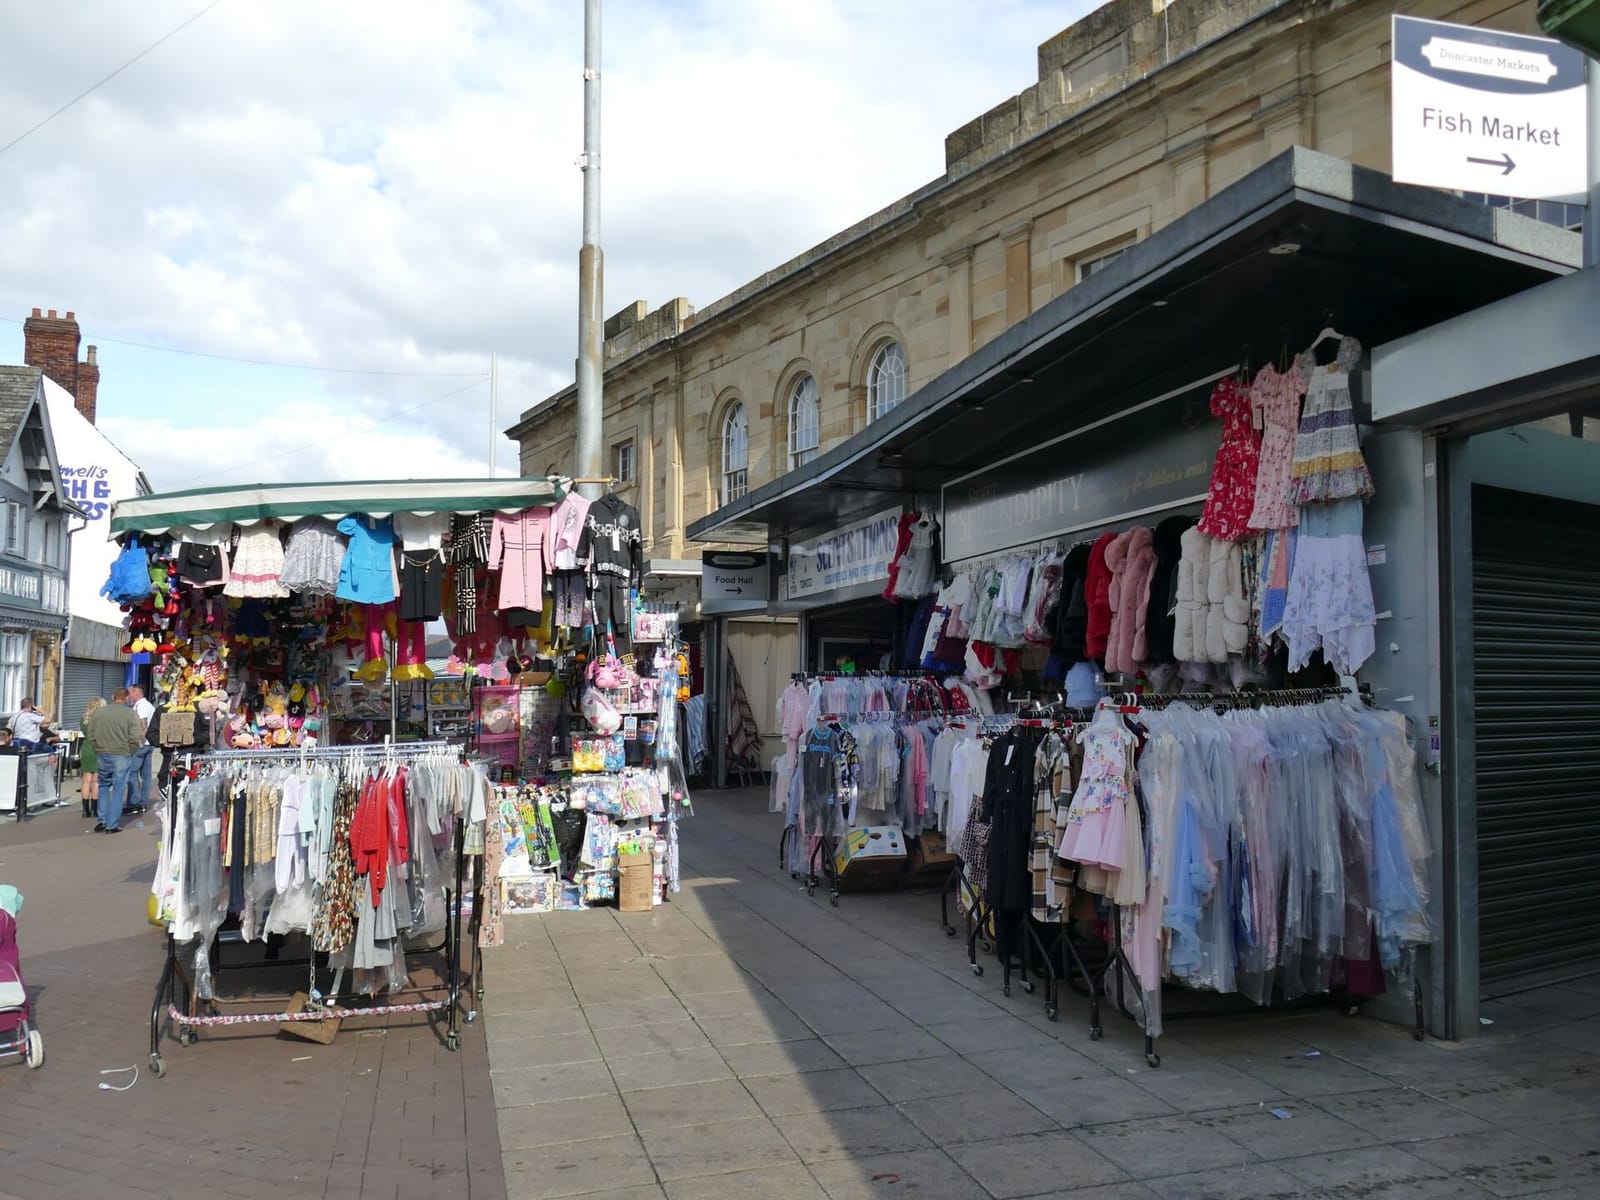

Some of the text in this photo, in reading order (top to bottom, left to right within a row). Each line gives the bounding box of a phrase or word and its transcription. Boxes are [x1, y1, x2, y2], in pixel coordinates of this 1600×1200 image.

[1439, 48, 1541, 73] Doncaster Markets
[1422, 107, 1560, 146] Fish Market
[816, 515, 898, 573] SCENTSATIONS
[715, 575, 754, 585] Food Hall
